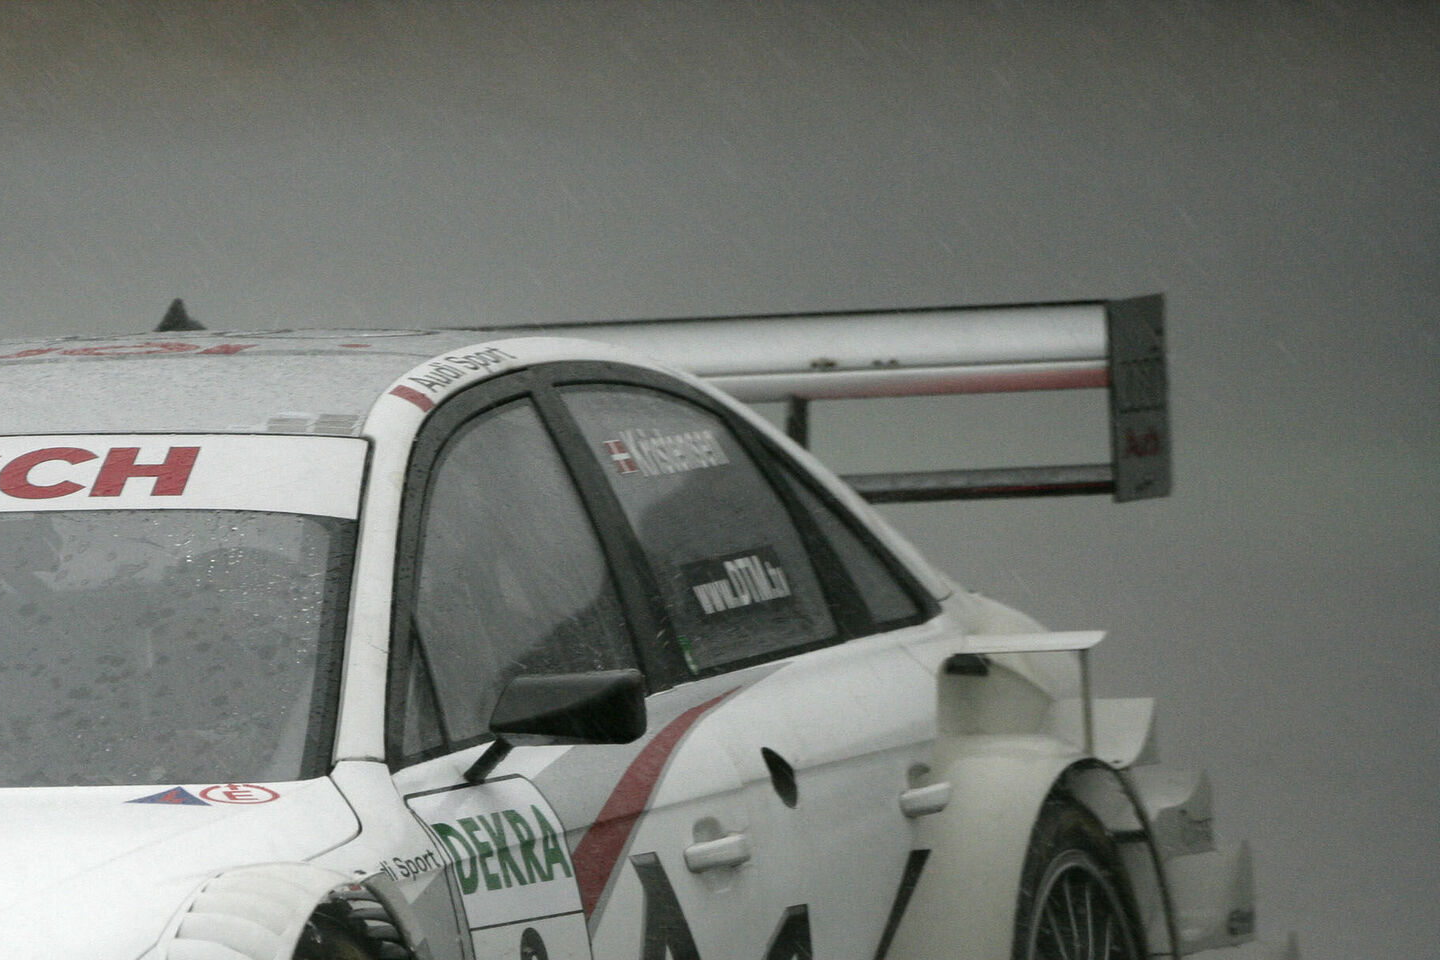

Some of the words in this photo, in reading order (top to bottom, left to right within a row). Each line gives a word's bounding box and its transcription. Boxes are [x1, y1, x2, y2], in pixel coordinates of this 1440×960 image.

[408, 361, 464, 393] Audi
[445, 346, 517, 375] Sport
[392, 849, 441, 881] Sport
[432, 805, 573, 895] DEKRA
